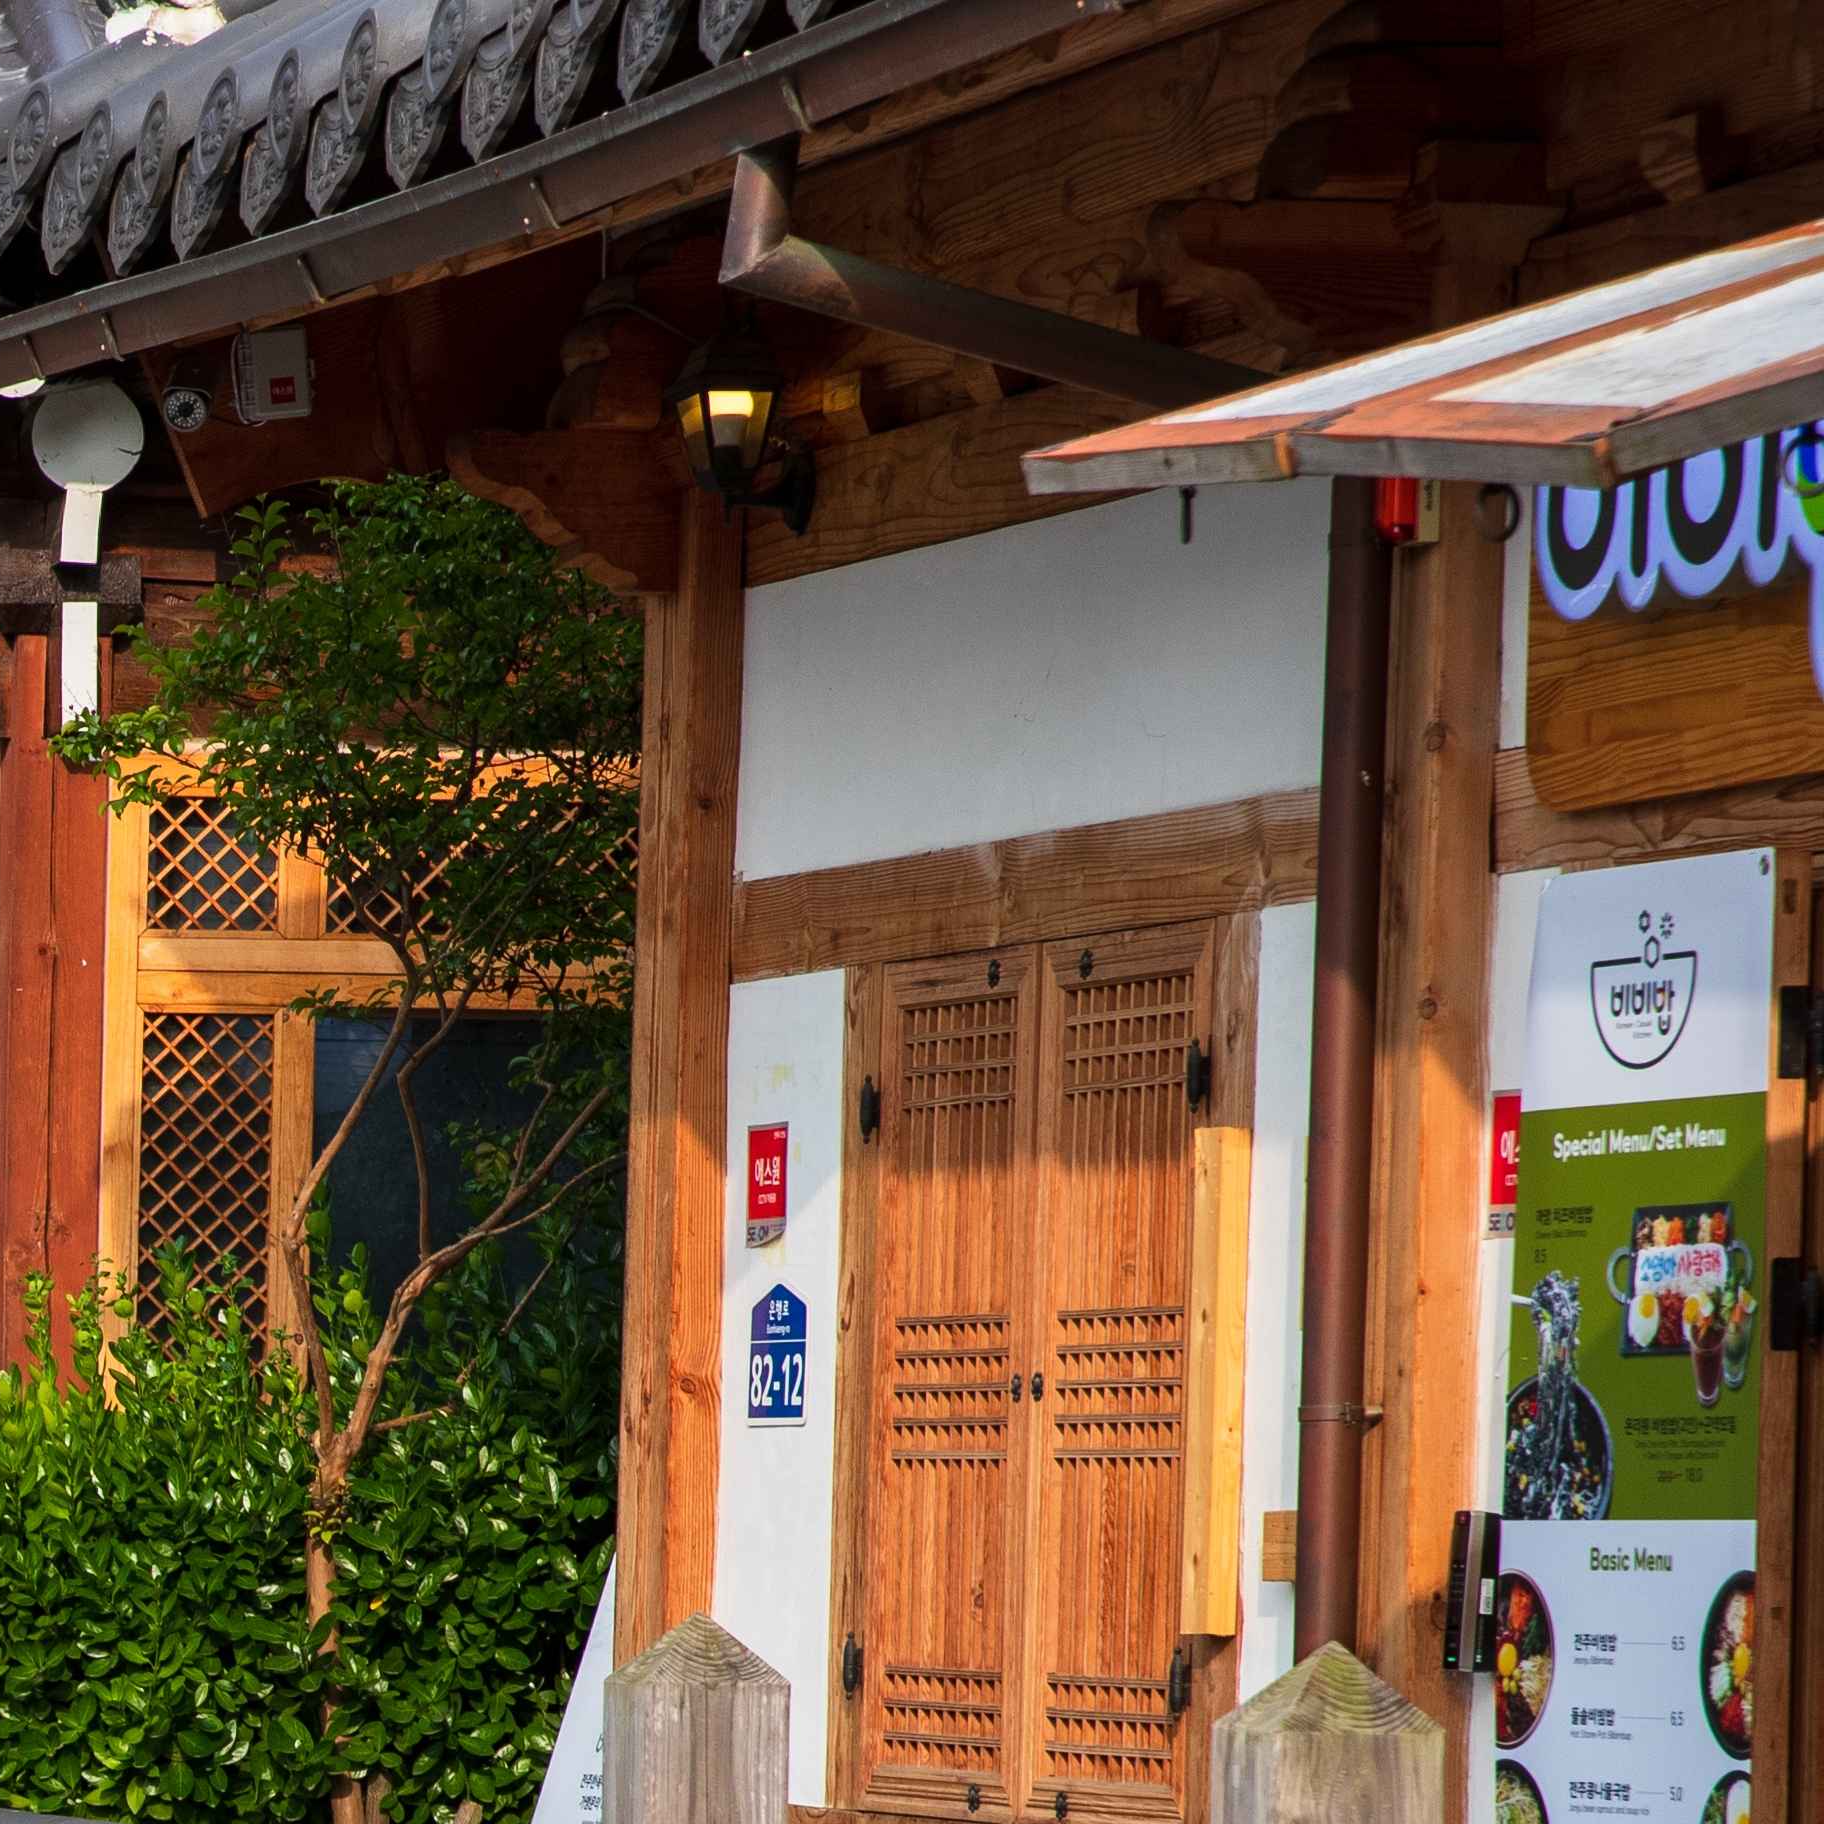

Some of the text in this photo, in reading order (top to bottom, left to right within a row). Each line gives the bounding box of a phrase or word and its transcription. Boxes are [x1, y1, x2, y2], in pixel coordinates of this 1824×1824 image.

[1553, 1122, 1727, 1162] Special Menu/Set Menu
[754, 1155, 781, 1187] 에스원
[768, 1300, 790, 1321] 은행로
[751, 1353, 803, 1407] 82-12
[1589, 1546, 1673, 1572] Basic Menu
